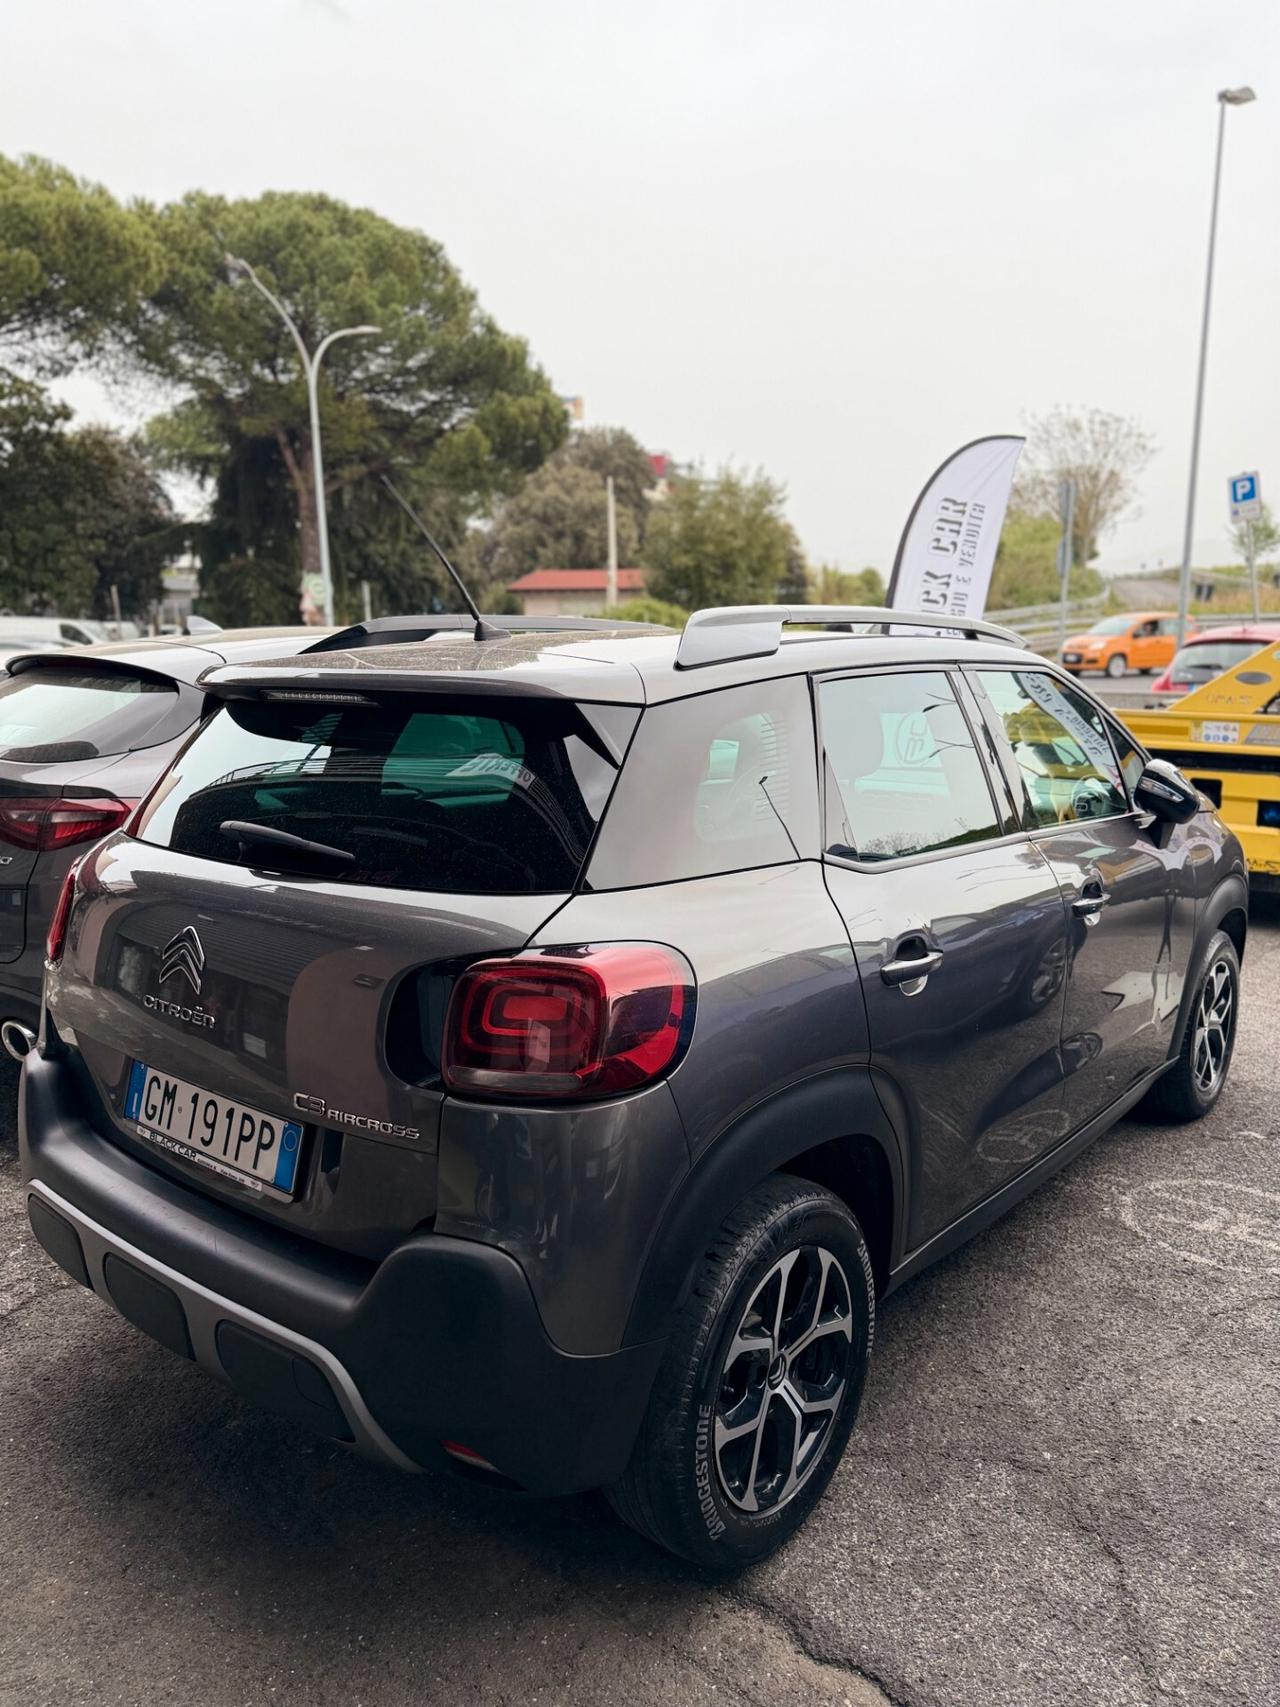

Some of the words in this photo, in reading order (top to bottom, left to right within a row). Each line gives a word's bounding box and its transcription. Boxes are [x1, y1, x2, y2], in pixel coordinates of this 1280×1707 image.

[1235, 480, 1251, 500] P
[930, 496, 968, 557] CAR
[920, 570, 953, 615] CK
[293, 1092, 327, 1116] C3
[327, 1108, 420, 1140] AIRCROSS
[179, 1146, 198, 1161] CAR
[856, 1238, 876, 1358] BRIDGESTONE
[695, 1404, 727, 1541] BRIDGESTONE
